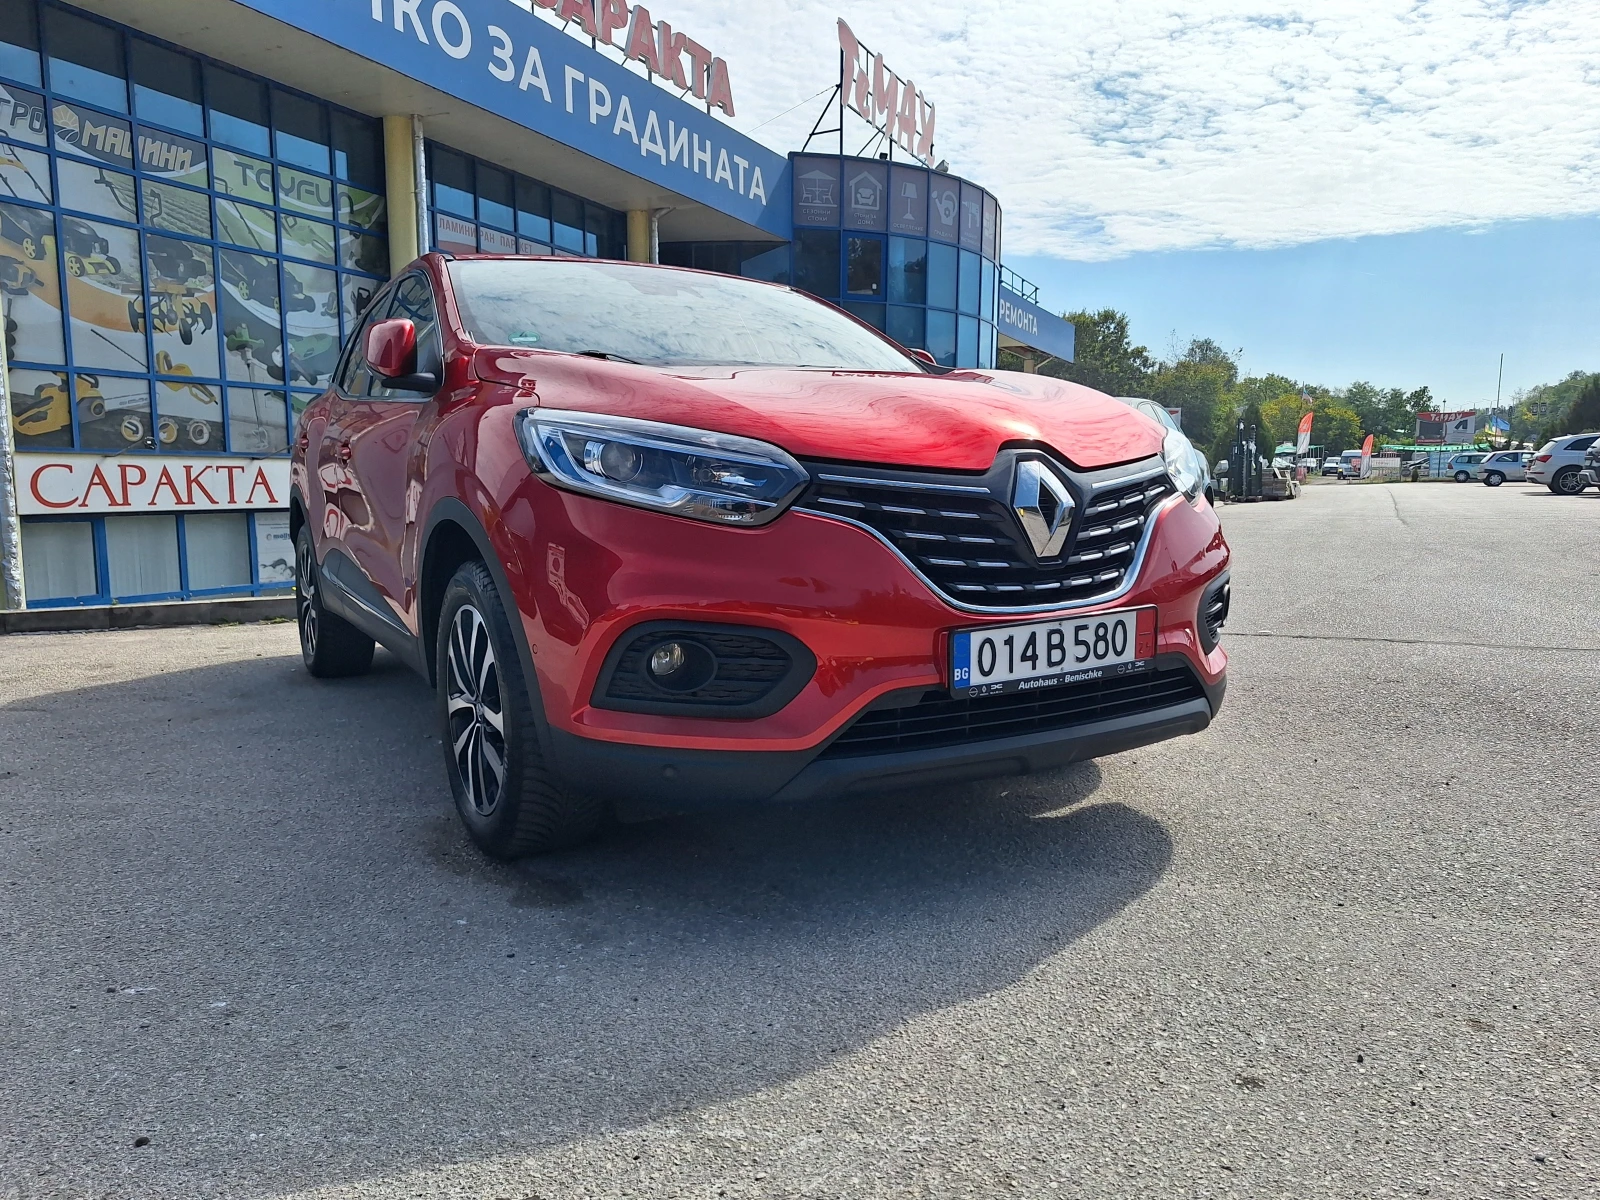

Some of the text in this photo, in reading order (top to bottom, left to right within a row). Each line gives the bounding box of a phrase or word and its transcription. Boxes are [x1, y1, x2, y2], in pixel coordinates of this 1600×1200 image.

[487, 25, 552, 103] ЗА
[565, 65, 767, 206] ГРАДИНАТА
[81, 119, 193, 174] МАШИНИ
[1000, 298, 1038, 337] РЕМОНТА
[30, 463, 279, 509] САРАКТА
[954, 667, 970, 681] BG
[1018, 677, 1058, 690] Autohaus
[1064, 669, 1103, 683] Benischke
